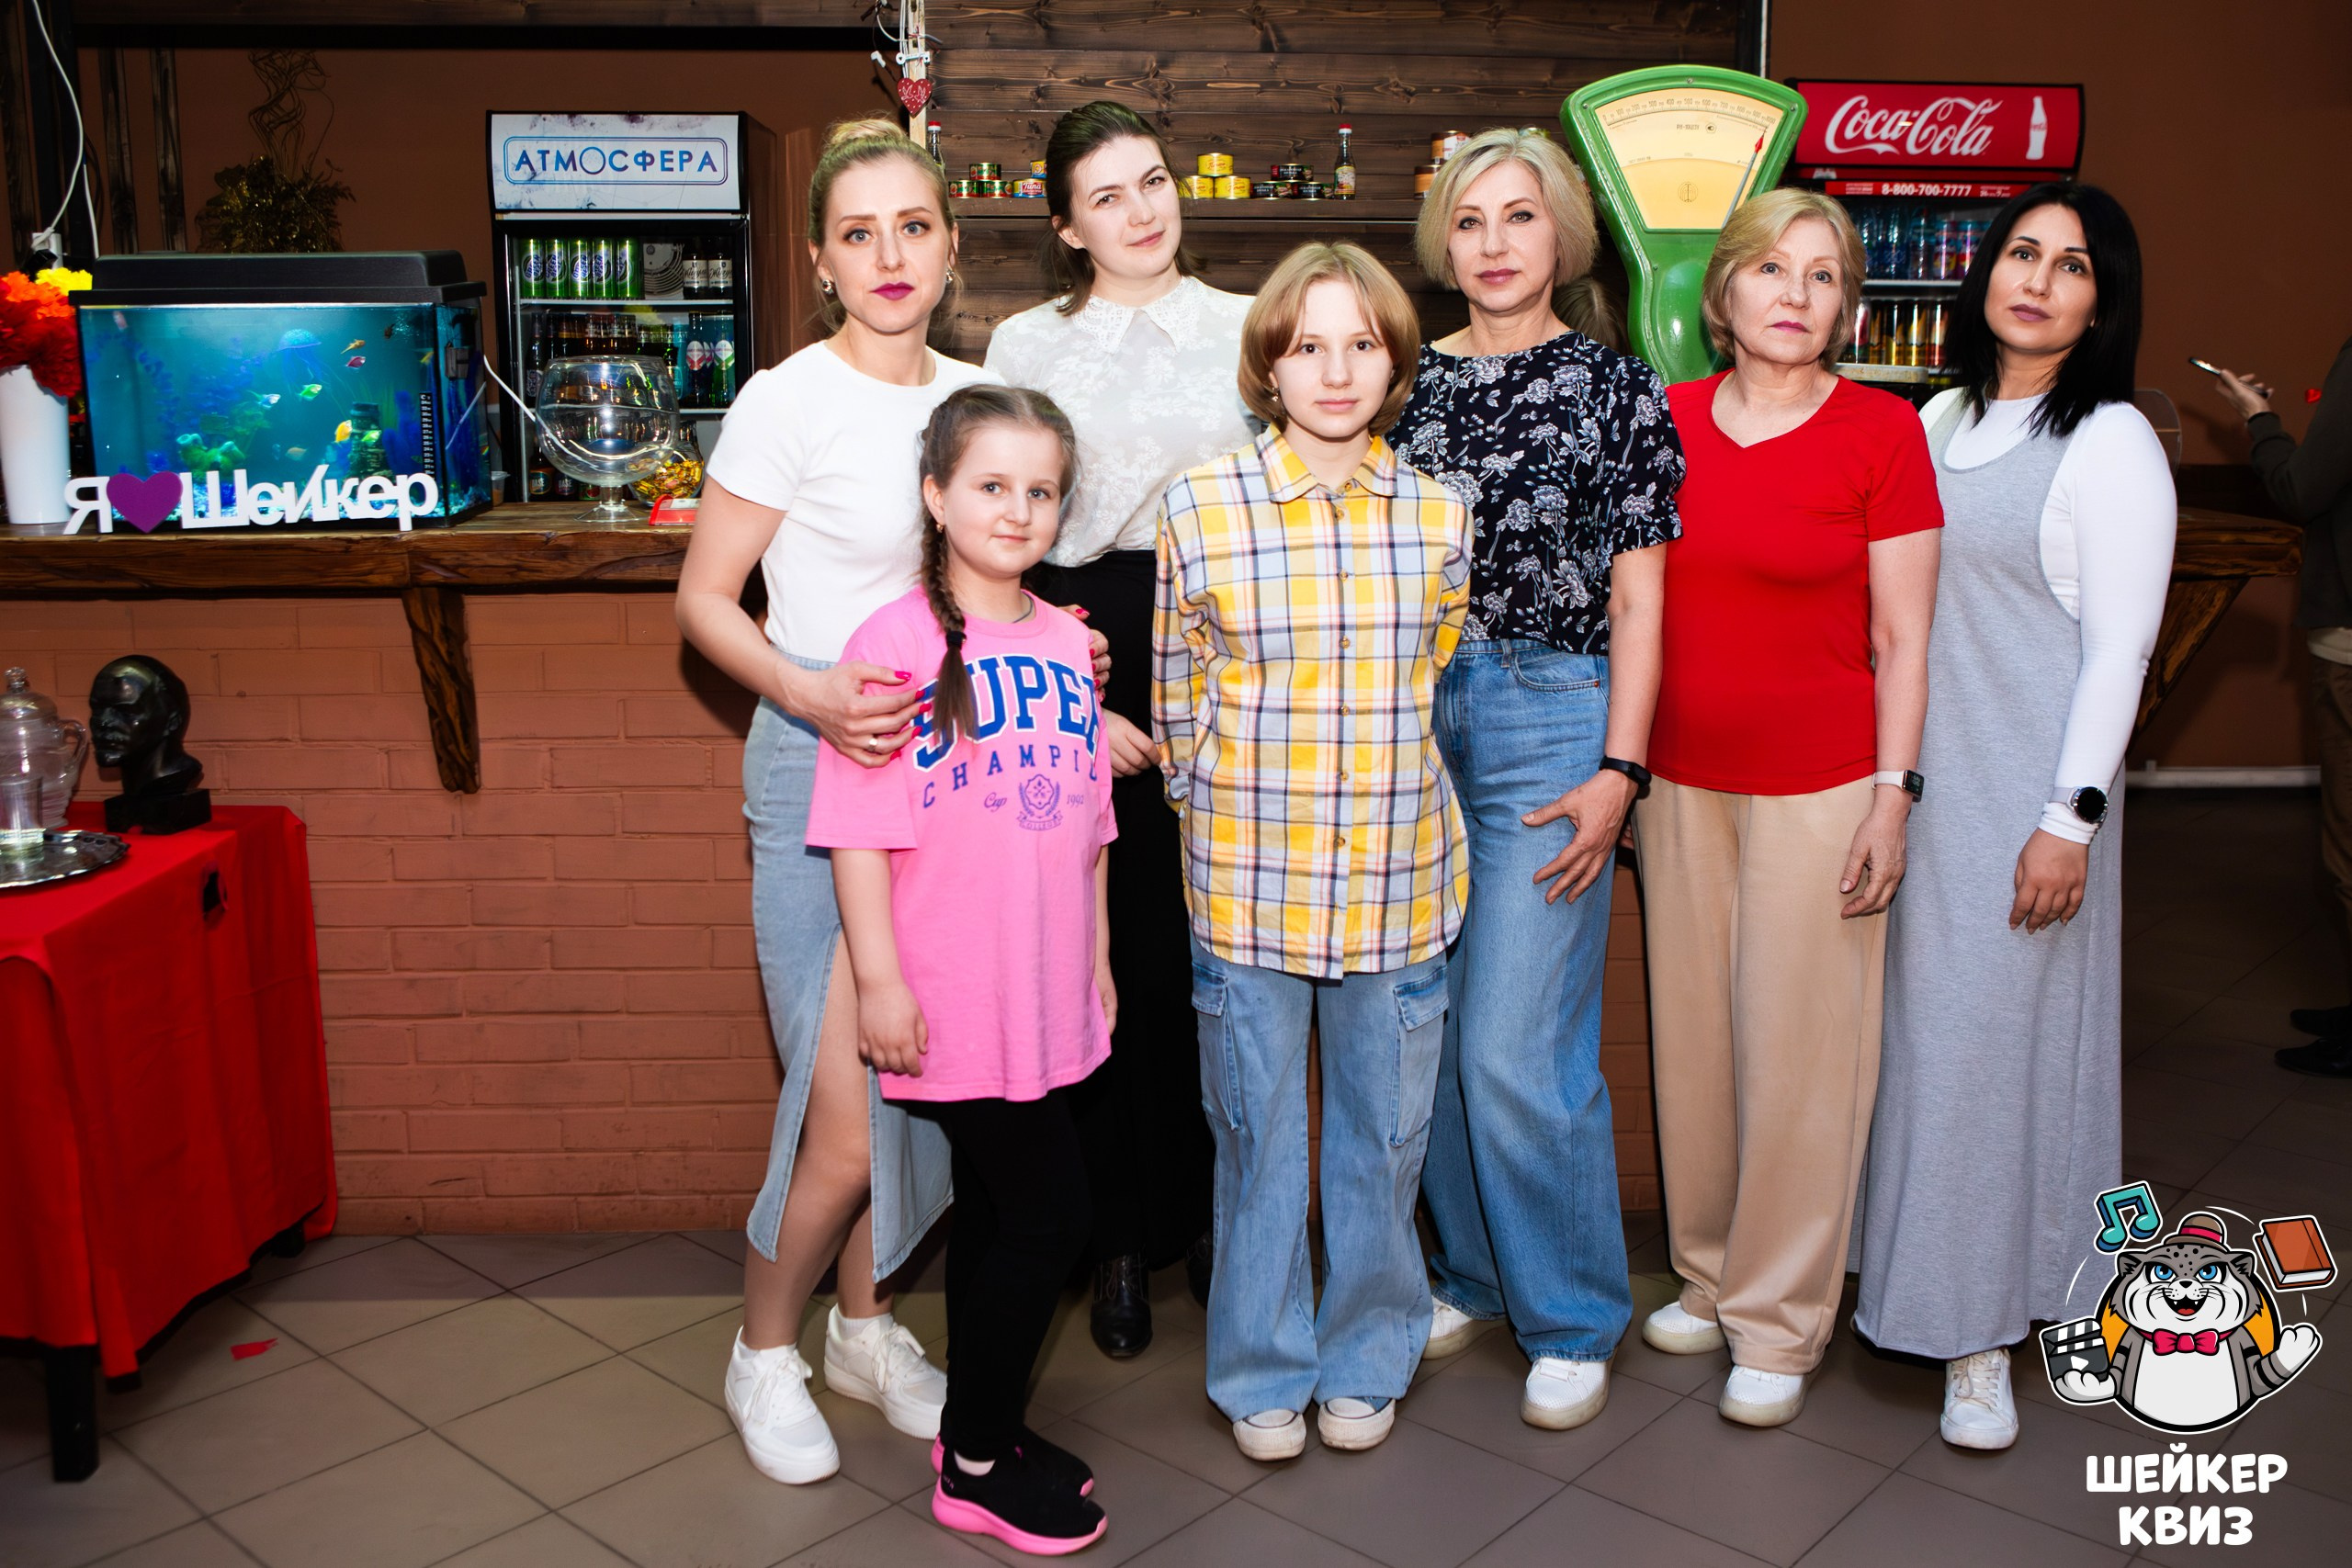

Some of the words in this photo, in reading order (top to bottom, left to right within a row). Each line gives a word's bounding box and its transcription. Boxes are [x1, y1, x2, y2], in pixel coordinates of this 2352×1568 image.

[1825, 95, 2003, 156] Coca-Cola
[514, 146, 718, 175] АТМОСФЕРА
[1882, 183, 1972, 197] 8-800-700-7777
[62, 476, 113, 536] Я
[179, 464, 439, 532] Шейкер
[984, 792, 1008, 812] Cup
